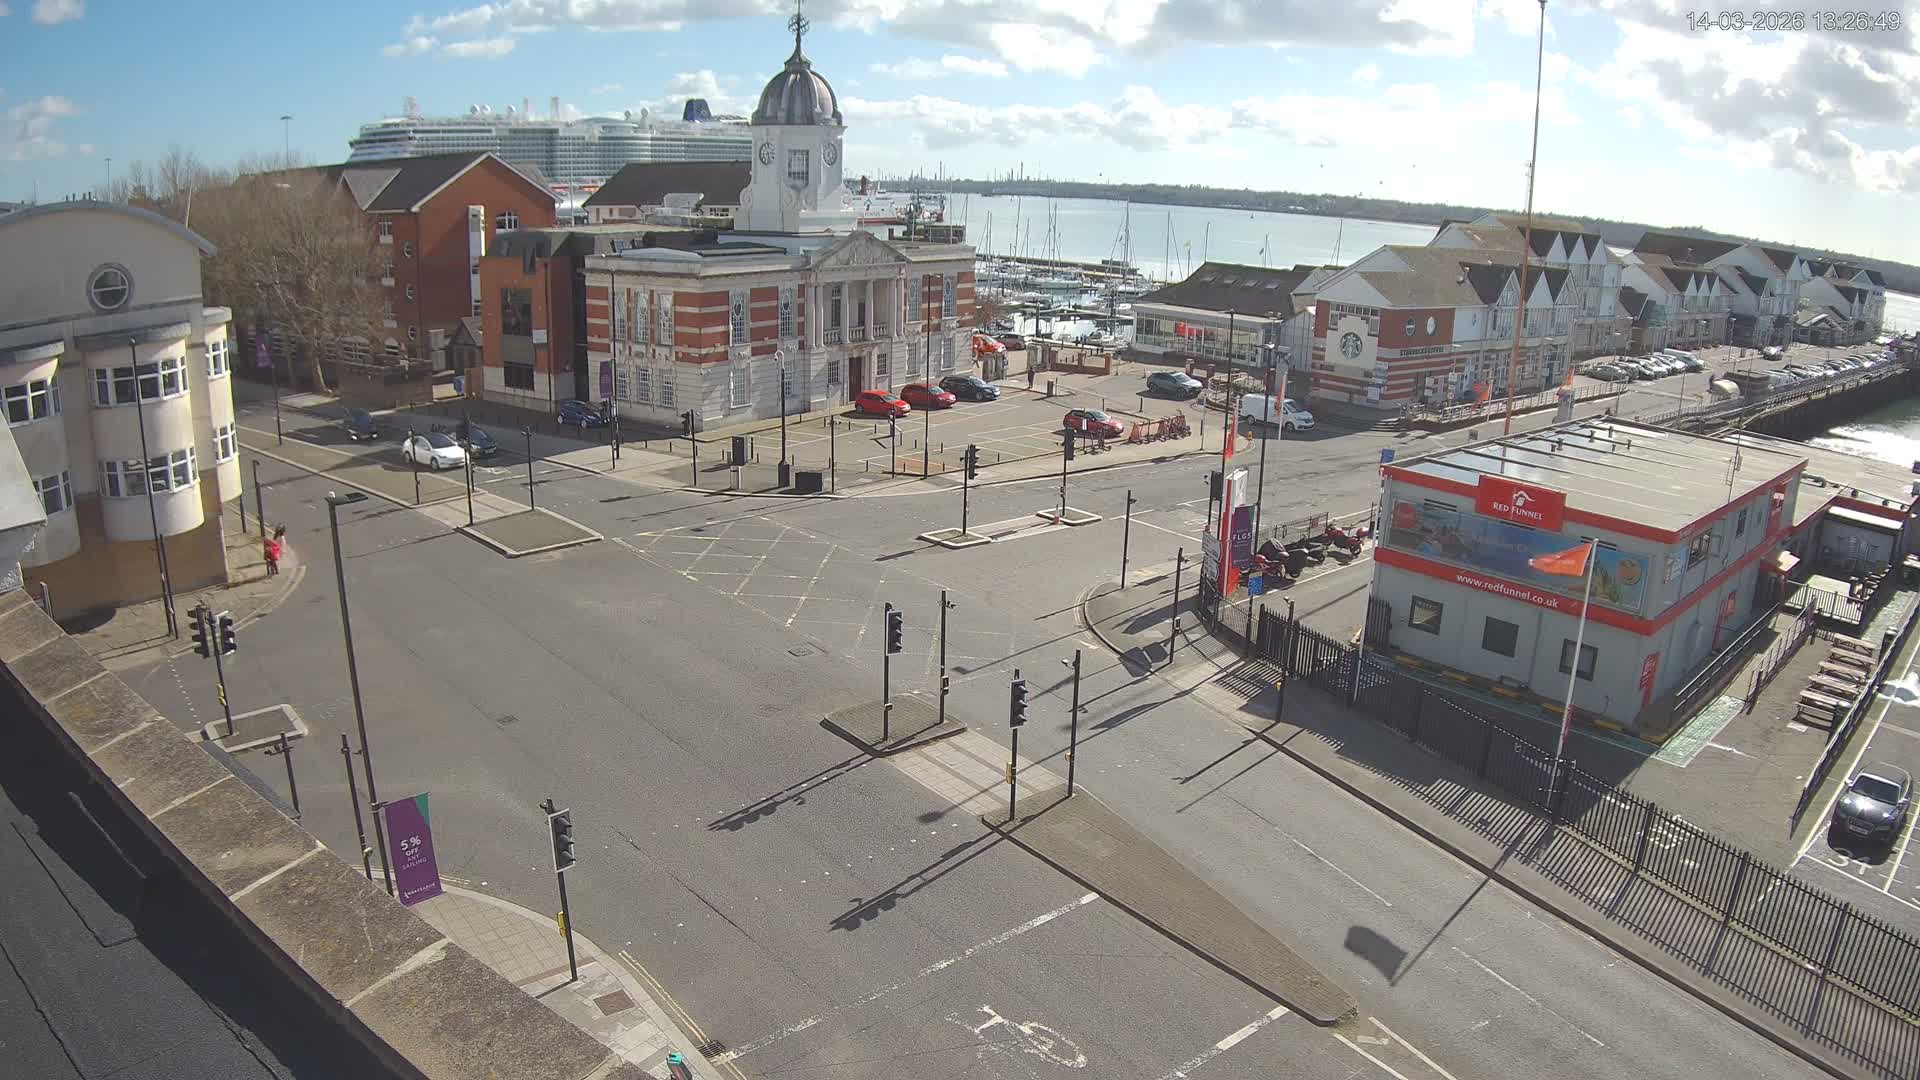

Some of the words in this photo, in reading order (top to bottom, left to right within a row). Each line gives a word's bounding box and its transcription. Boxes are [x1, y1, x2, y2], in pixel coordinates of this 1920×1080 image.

[1492, 501, 1509, 514] RED
[1511, 505, 1543, 521] FUNNEL
[1456, 574, 1559, 608] www.redfunnel.co.uk
[405, 847, 419, 856] OFF
[401, 858, 427, 870] SAILING
